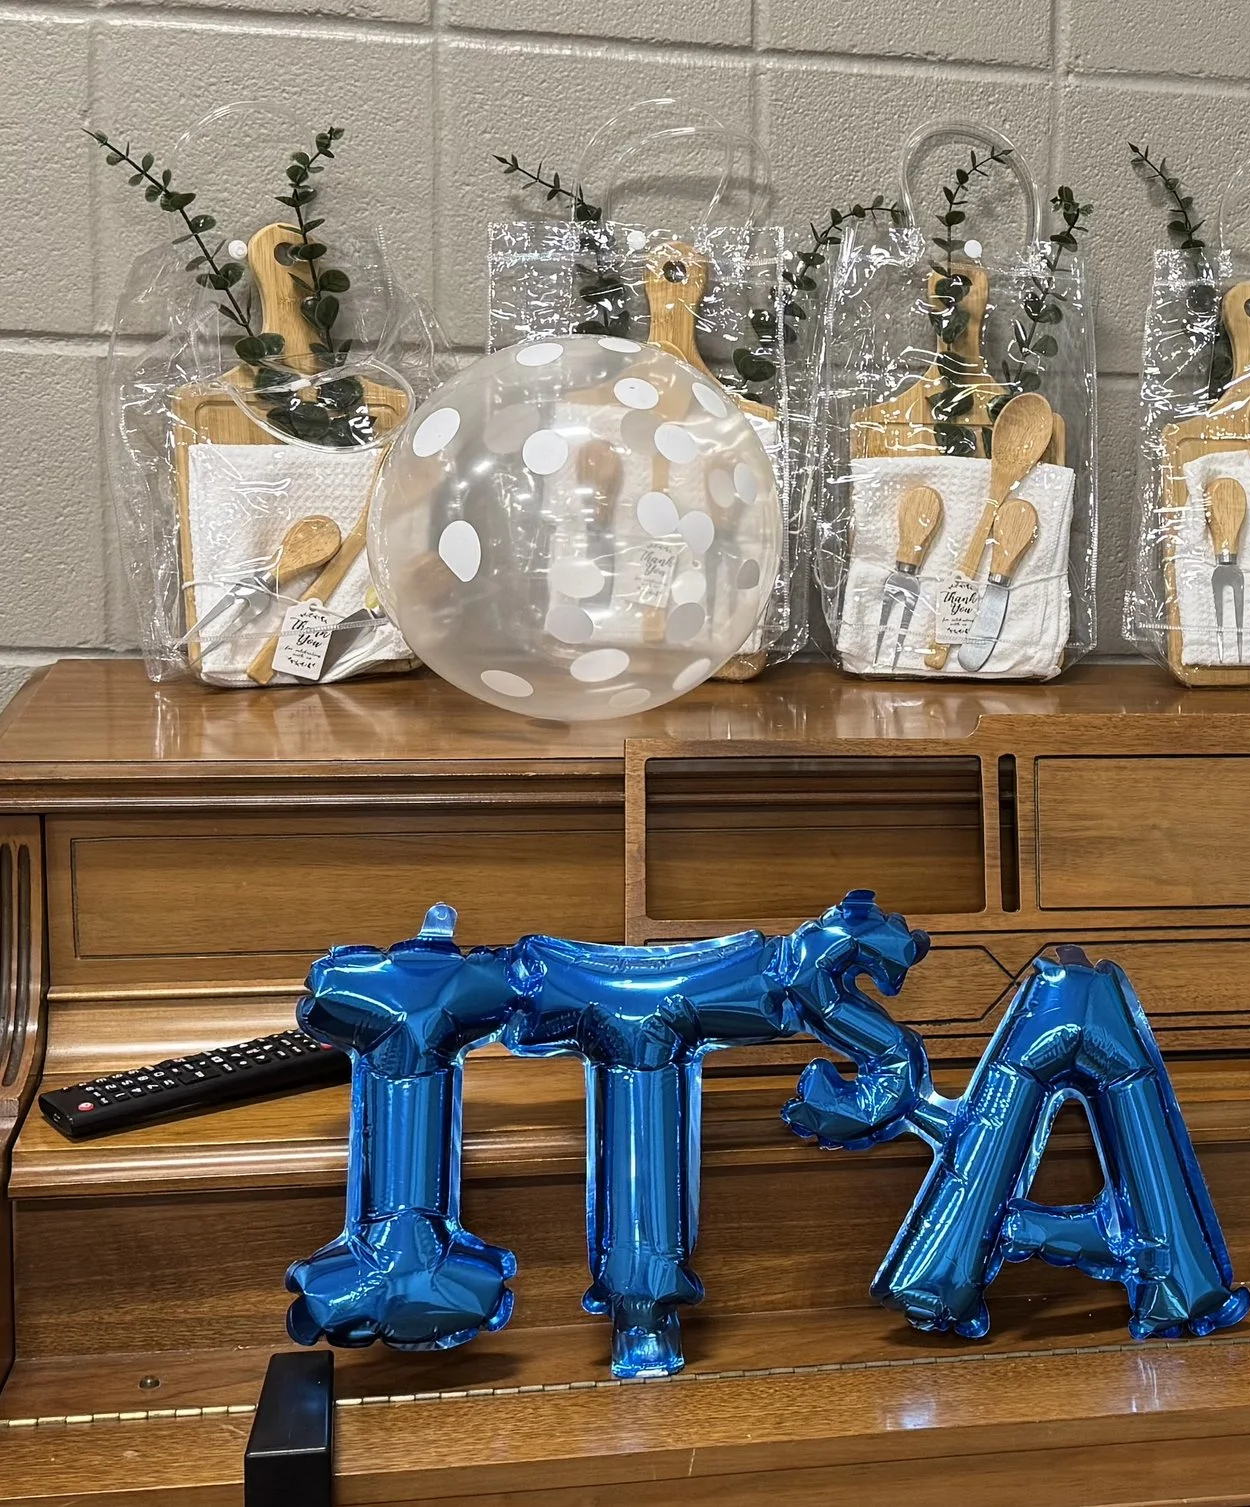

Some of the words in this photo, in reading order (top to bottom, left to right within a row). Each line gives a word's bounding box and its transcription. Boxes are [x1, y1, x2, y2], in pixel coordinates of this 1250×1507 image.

[940, 591, 977, 605] Thank
[951, 603, 973, 615] You
[296, 634, 322, 648] You
